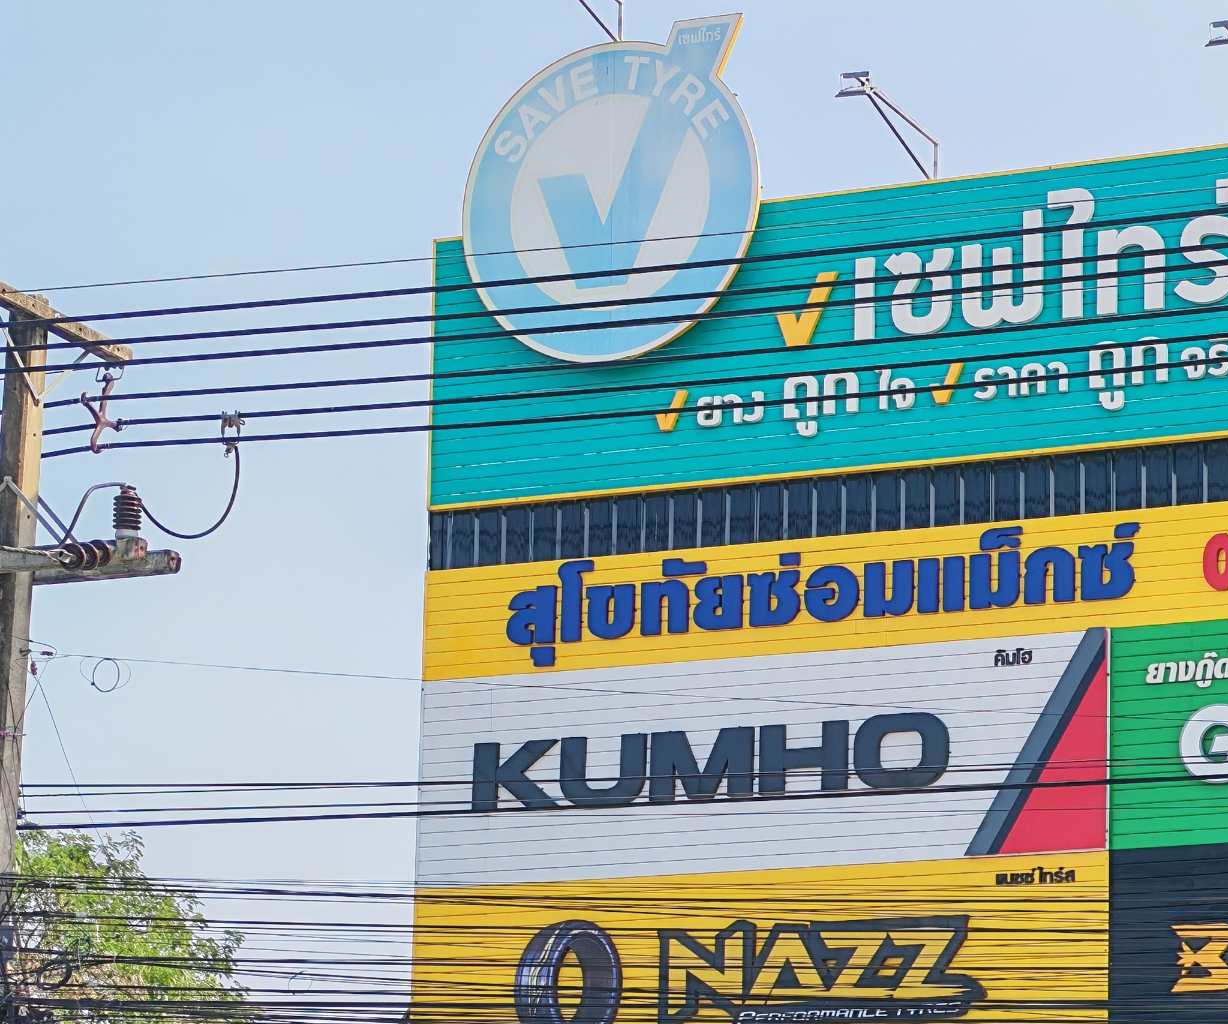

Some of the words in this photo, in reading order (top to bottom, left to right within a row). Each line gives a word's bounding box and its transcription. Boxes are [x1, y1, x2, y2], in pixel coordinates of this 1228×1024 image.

[495, 62, 600, 163] SAVE
[623, 55, 730, 142] TYRE
[696, 391, 765, 428] ยาง
[783, 371, 860, 437] ถูก
[973, 360, 1069, 400] ราคา
[1088, 336, 1169, 412] ถูก
[506, 522, 1142, 667] สุโขทัยซ่อมแม็กซ์
[472, 712, 951, 811] KUMHO
